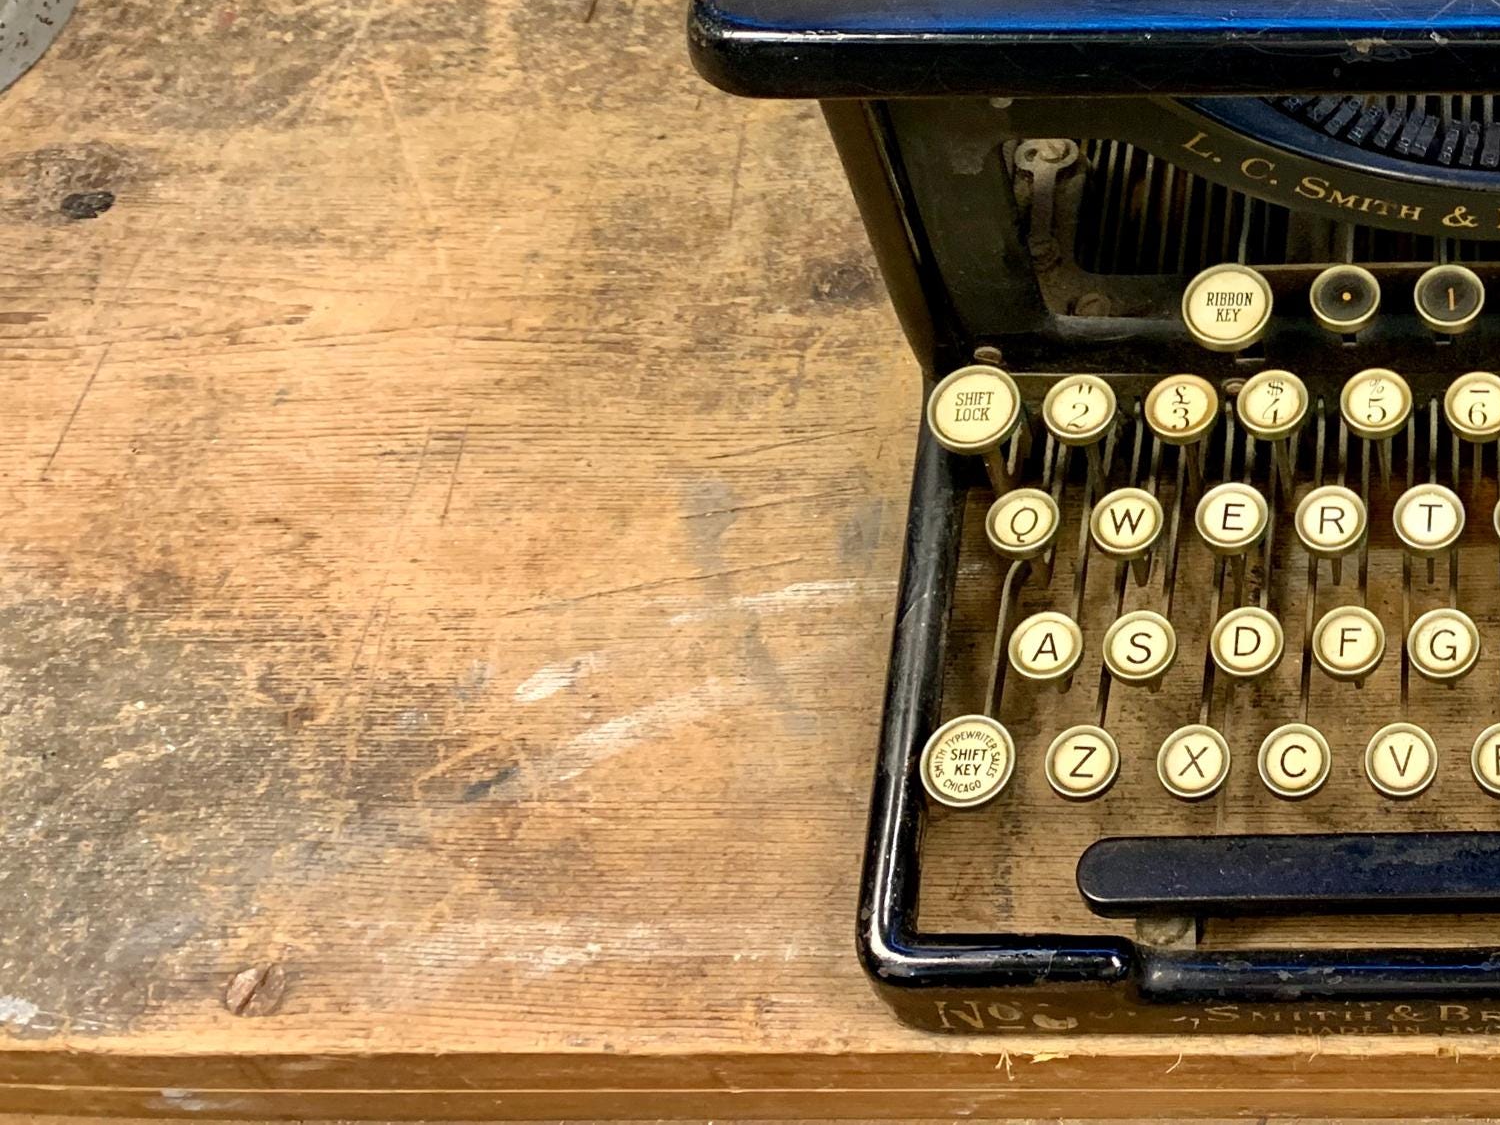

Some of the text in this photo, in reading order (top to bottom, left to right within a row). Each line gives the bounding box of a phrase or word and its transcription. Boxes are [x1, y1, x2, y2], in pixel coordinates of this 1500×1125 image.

[1182, 132, 1222, 163] L.
[1241, 157, 1278, 186] C.
[1442, 205, 1478, 228] &
[1206, 292, 1253, 306] RIBBON
[1447, 287, 1456, 311] 1
[1216, 308, 1242, 322] KEY
[955, 392, 995, 407] SHIFT
[1267, 379, 1284, 397] $
[954, 407, 990, 422] LOCK
[1067, 403, 1089, 427] 2
[1172, 408, 1190, 429] 3
[1262, 398, 1284, 424] 4
[1367, 397, 1387, 423] 5
[1468, 402, 1488, 427] 6
[1010, 507, 1038, 543] Q
[1109, 508, 1146, 535] W
[1222, 503, 1245, 531] E
[1319, 506, 1345, 534] R
[1419, 503, 1443, 532] T
[1031, 632, 1059, 662] A
[1126, 632, 1152, 665] S
[1233, 626, 1261, 657] D
[1339, 627, 1362, 658] F
[1429, 629, 1458, 662] G
[934, 730, 1001, 778] SMITH TYPEWRITER SALES
[950, 748, 988, 761] SHIFT
[1069, 746, 1097, 777] Z
[1178, 744, 1209, 778] X
[1280, 744, 1307, 777] C
[1389, 744, 1414, 777] V
[954, 763, 982, 776] KEY
[943, 778, 982, 794] CHICAGO
[1387, 1004, 1430, 1022] &
